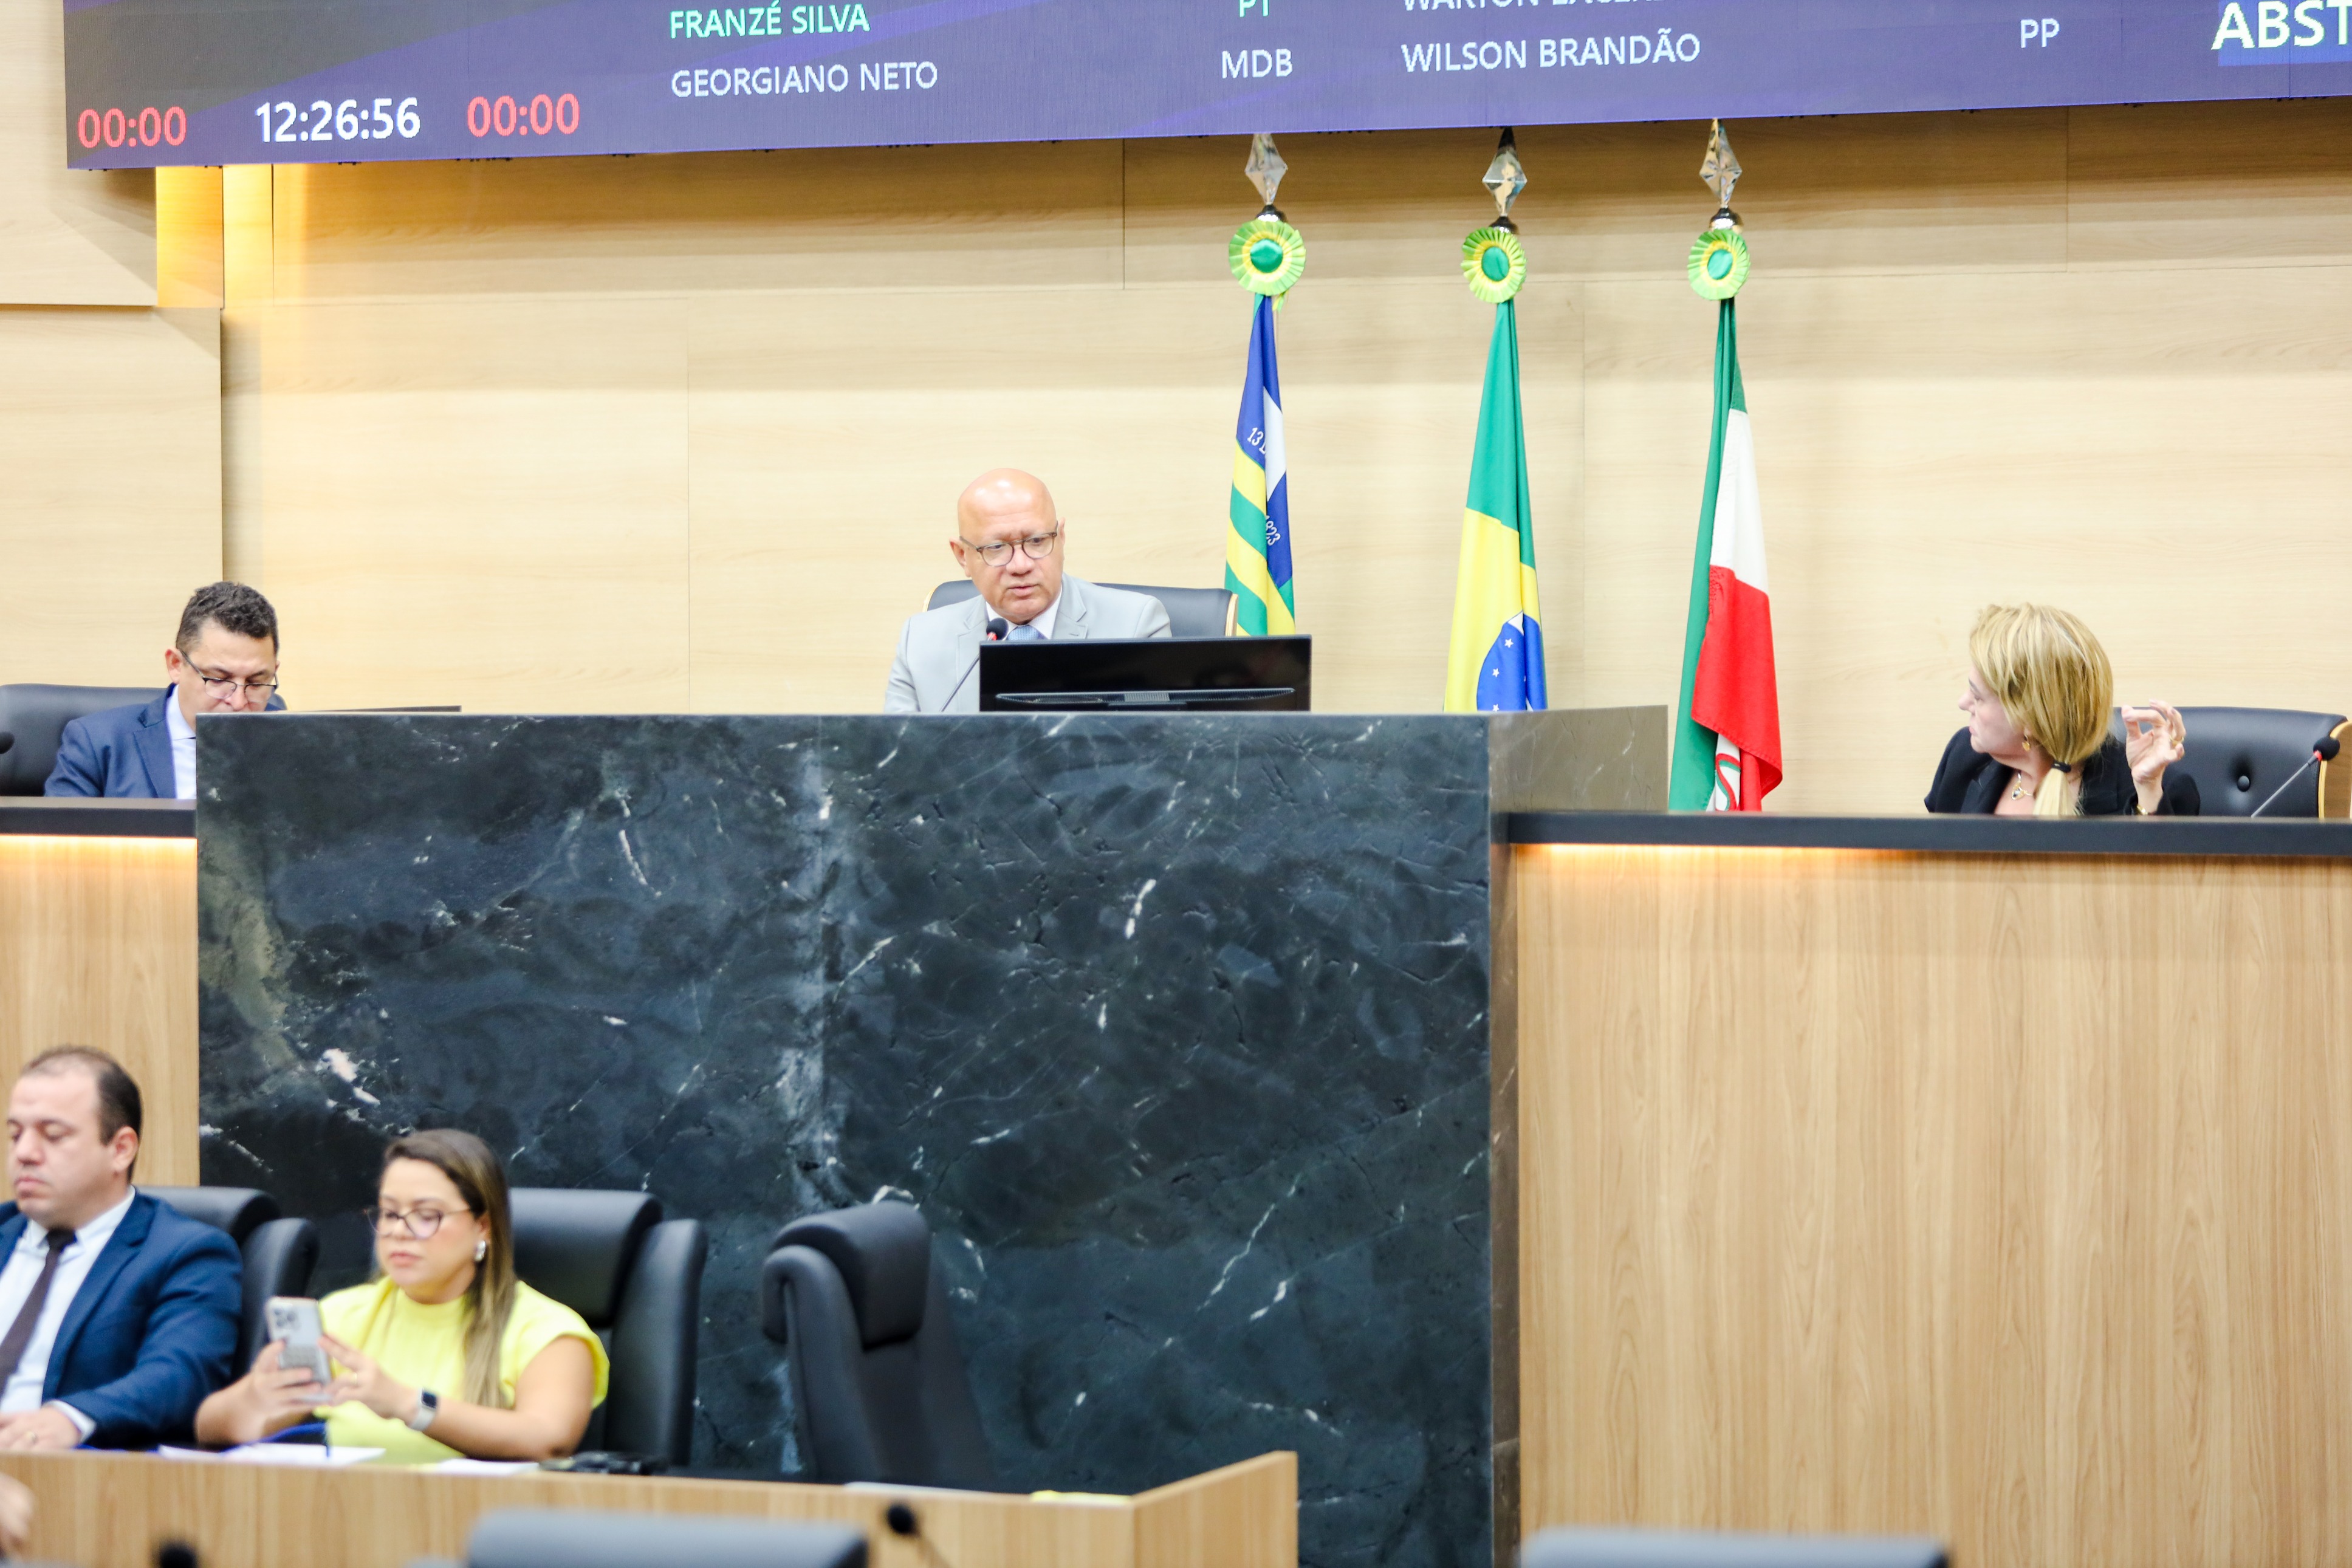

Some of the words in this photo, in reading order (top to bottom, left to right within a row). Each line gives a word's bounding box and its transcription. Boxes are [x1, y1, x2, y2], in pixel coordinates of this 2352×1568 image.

[670, 0, 782, 39] FRANZÉ
[792, 3, 871, 34] SILVA
[2020, 18, 2060, 49] PP
[1221, 48, 1293, 79] MDB
[1401, 39, 1526, 73] WILSON
[1540, 27, 1701, 68] BRANDÃO
[671, 64, 849, 98] GEORGIANO
[860, 61, 938, 91] NETO
[77, 106, 187, 148] 00:00
[256, 97, 420, 143] 12:26:56
[467, 93, 580, 137] 00:00
[1247, 427, 1264, 446] 13
